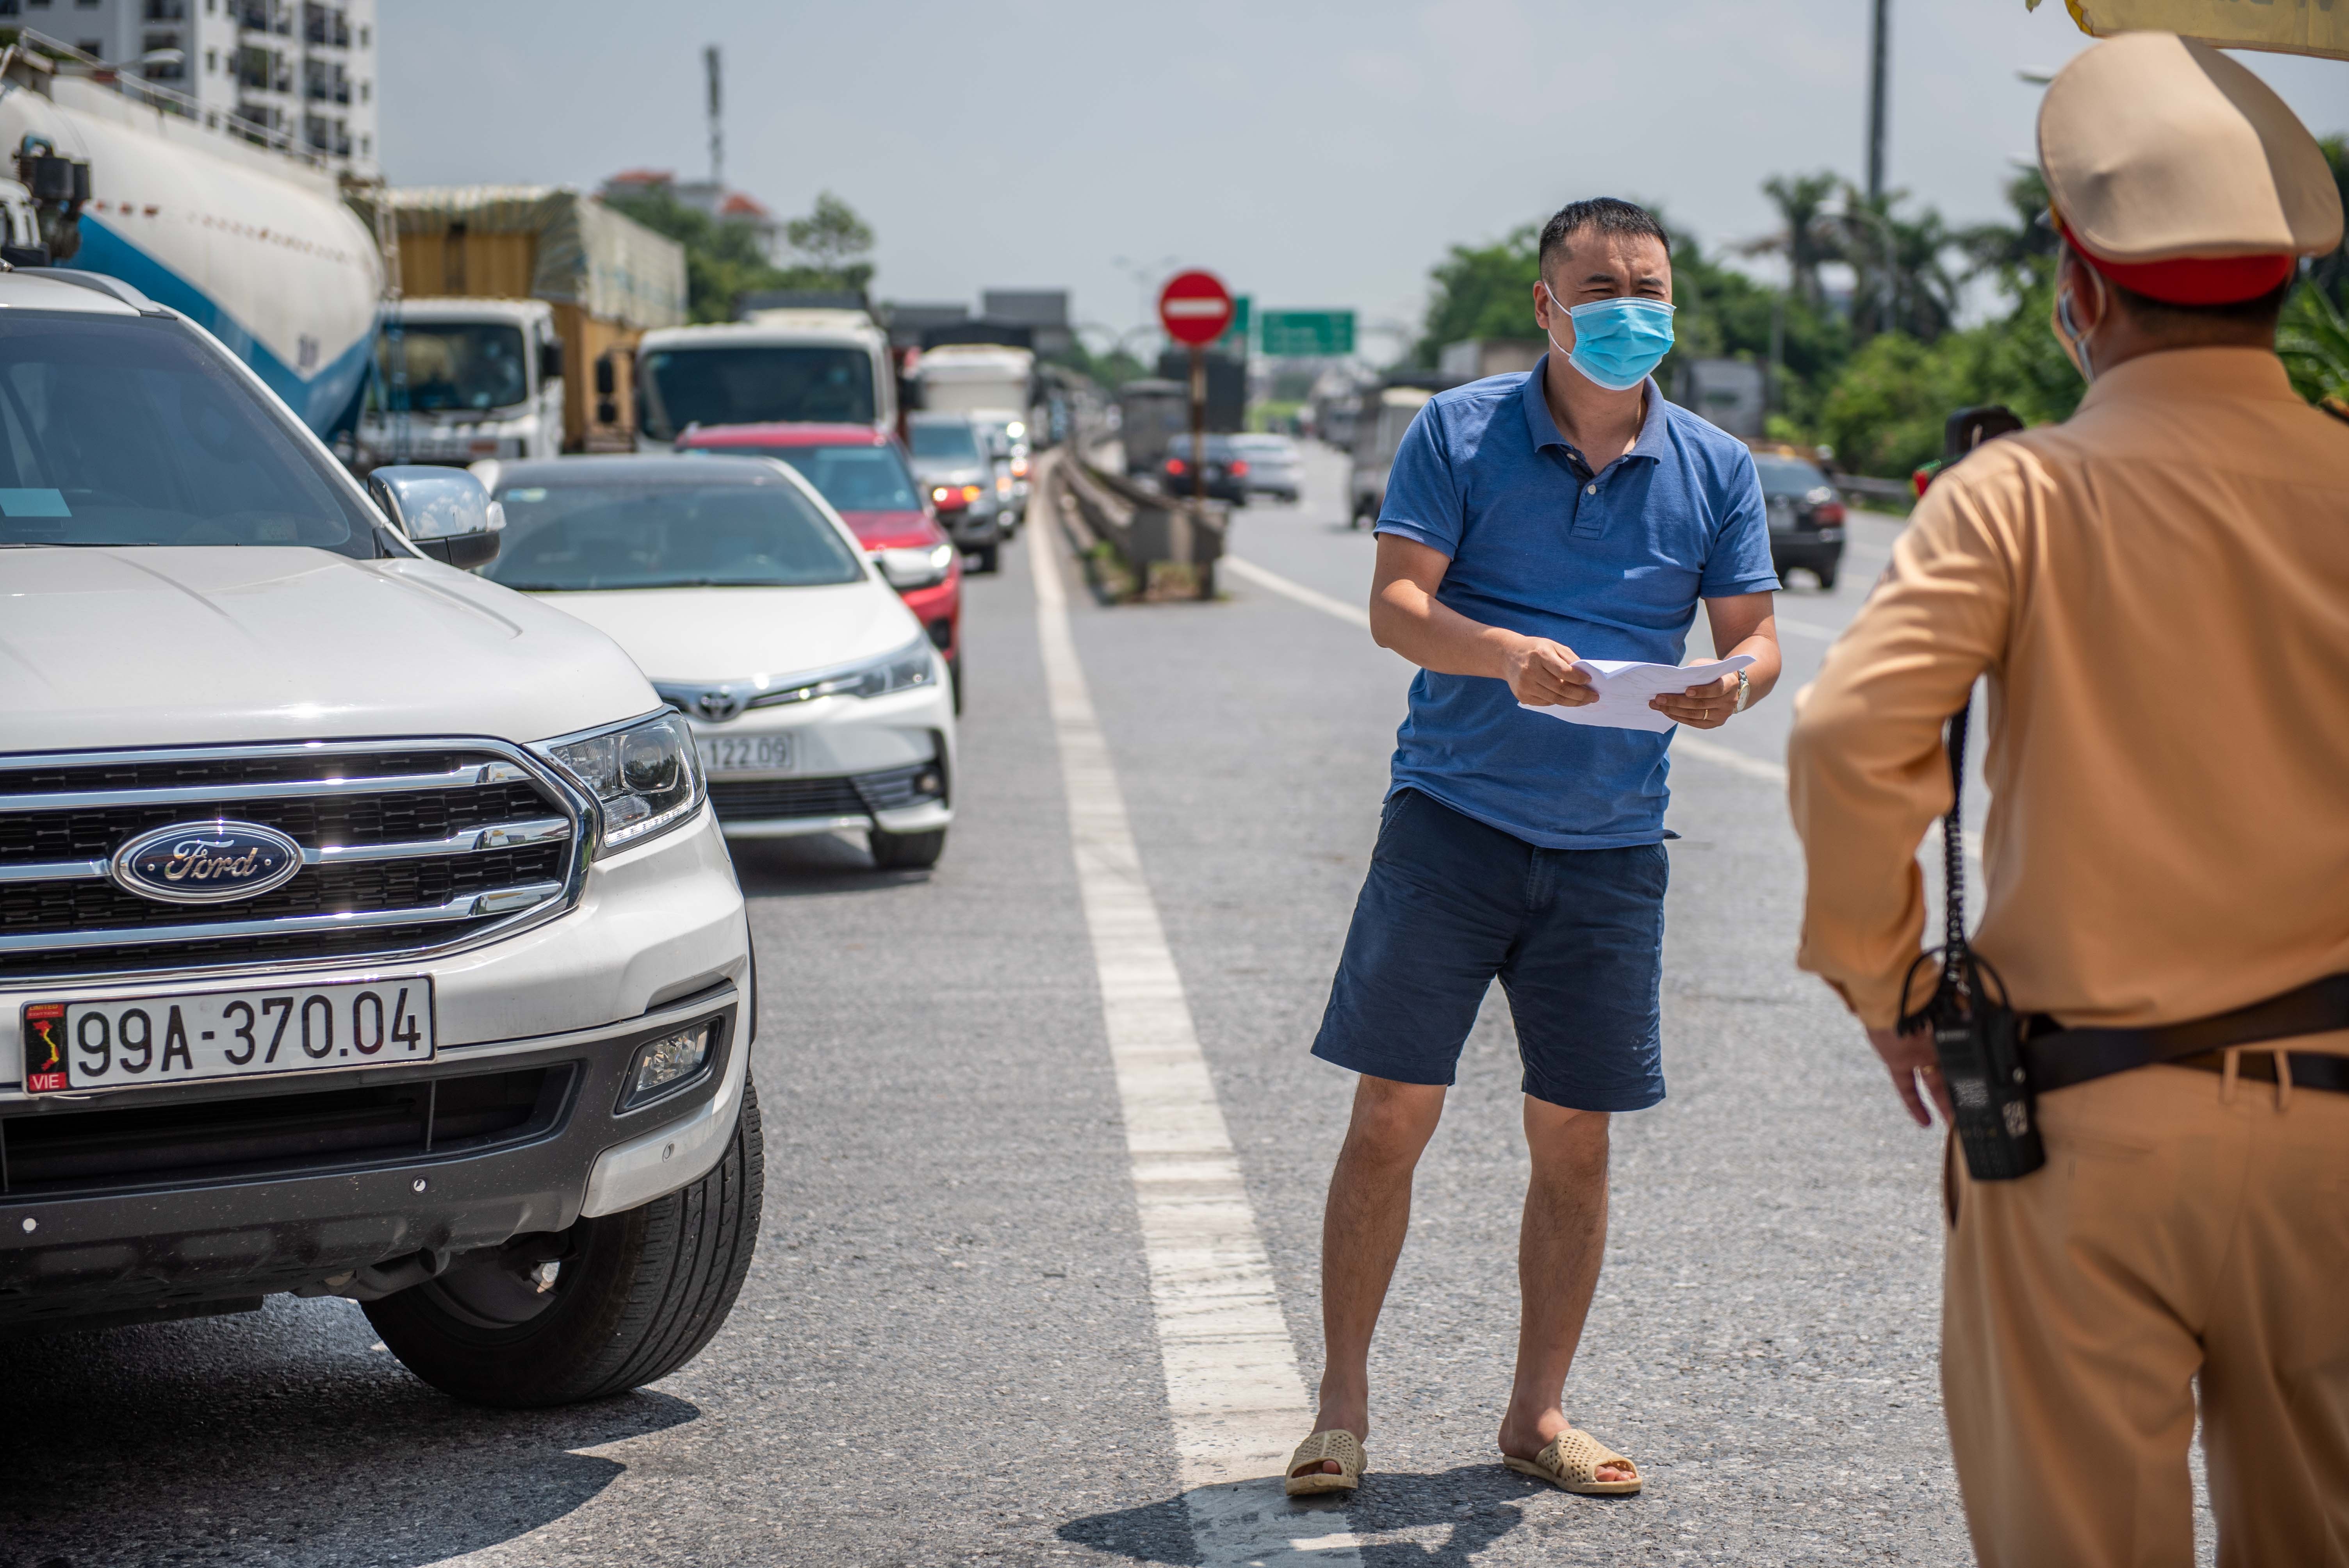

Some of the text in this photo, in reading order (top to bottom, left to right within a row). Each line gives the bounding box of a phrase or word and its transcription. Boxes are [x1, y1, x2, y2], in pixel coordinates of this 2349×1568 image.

[164, 840, 258, 881] Ford
[78, 987, 421, 1077] 99A-370.04
[32, 1074, 59, 1089] VIE
